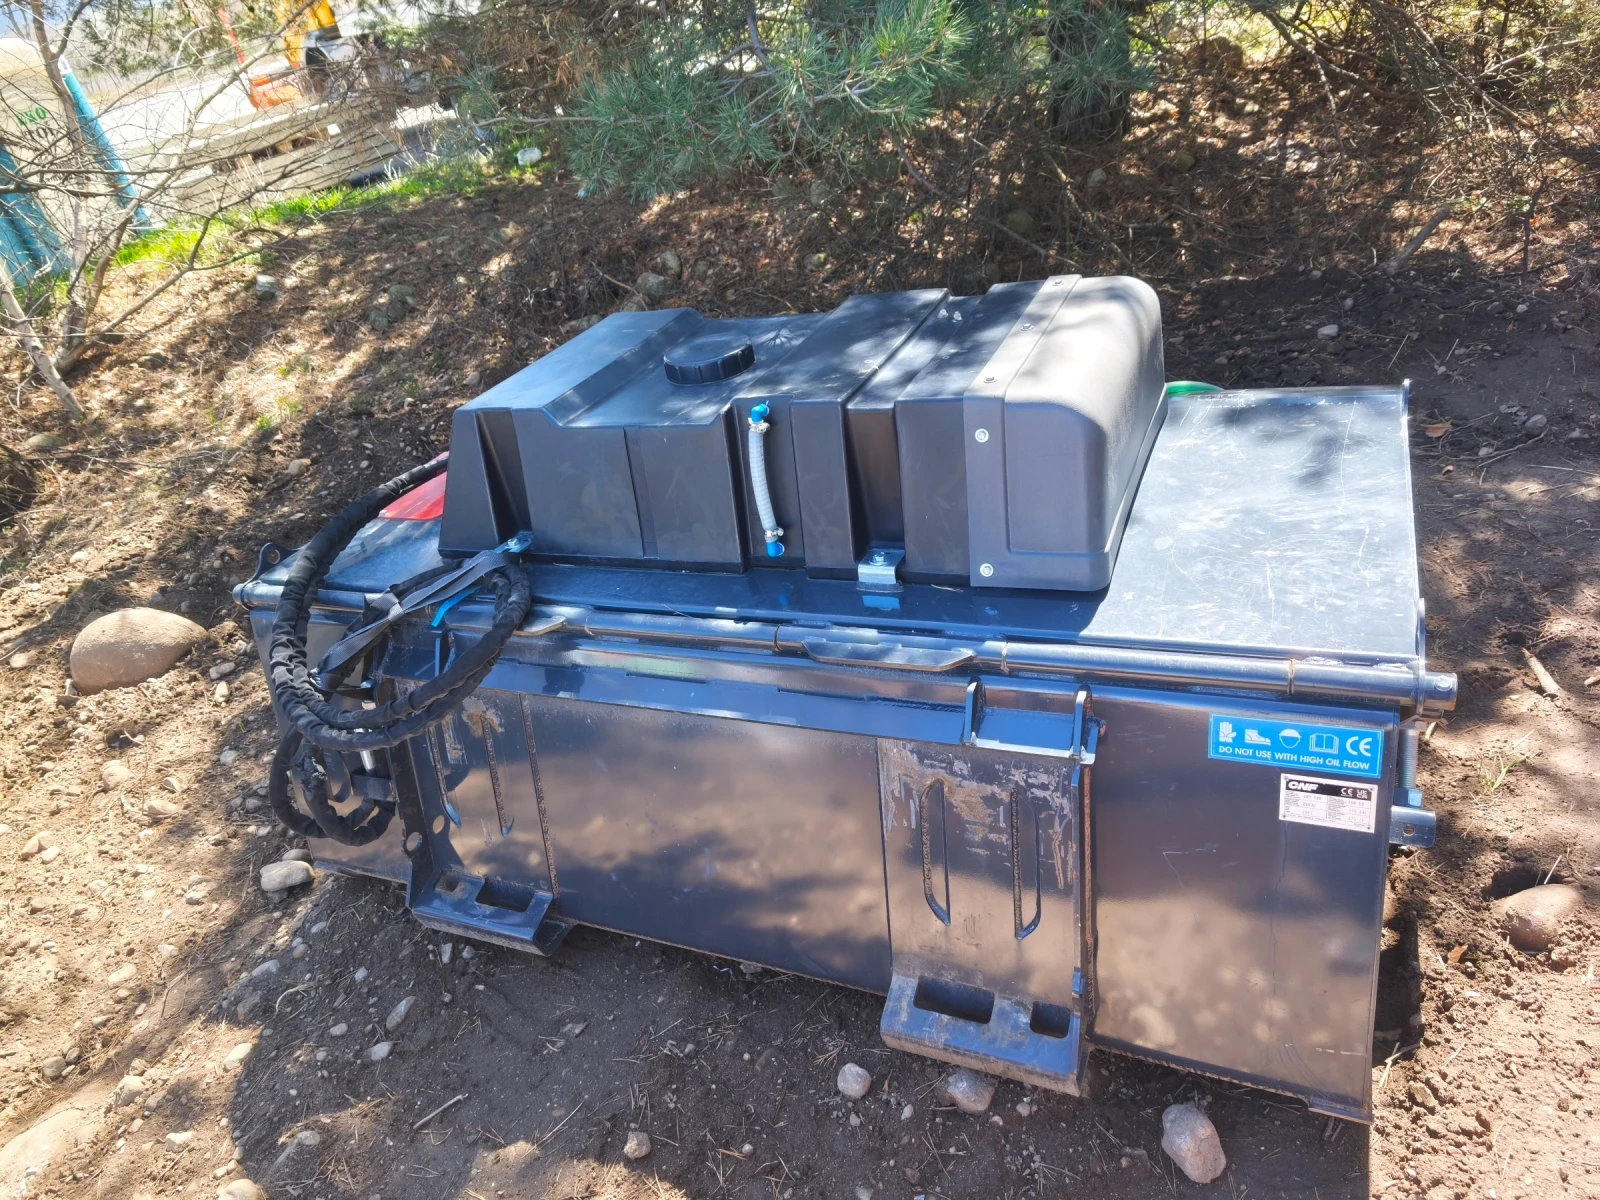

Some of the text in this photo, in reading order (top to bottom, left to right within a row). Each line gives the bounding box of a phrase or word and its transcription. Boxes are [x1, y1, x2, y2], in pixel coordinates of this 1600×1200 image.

[1345, 735, 1373, 757] CE
[1218, 746, 1371, 770] DO NOT USE WITH HIGH OIL FLOW
[1288, 781, 1319, 791] CNF
[1340, 787, 1353, 795] CE
